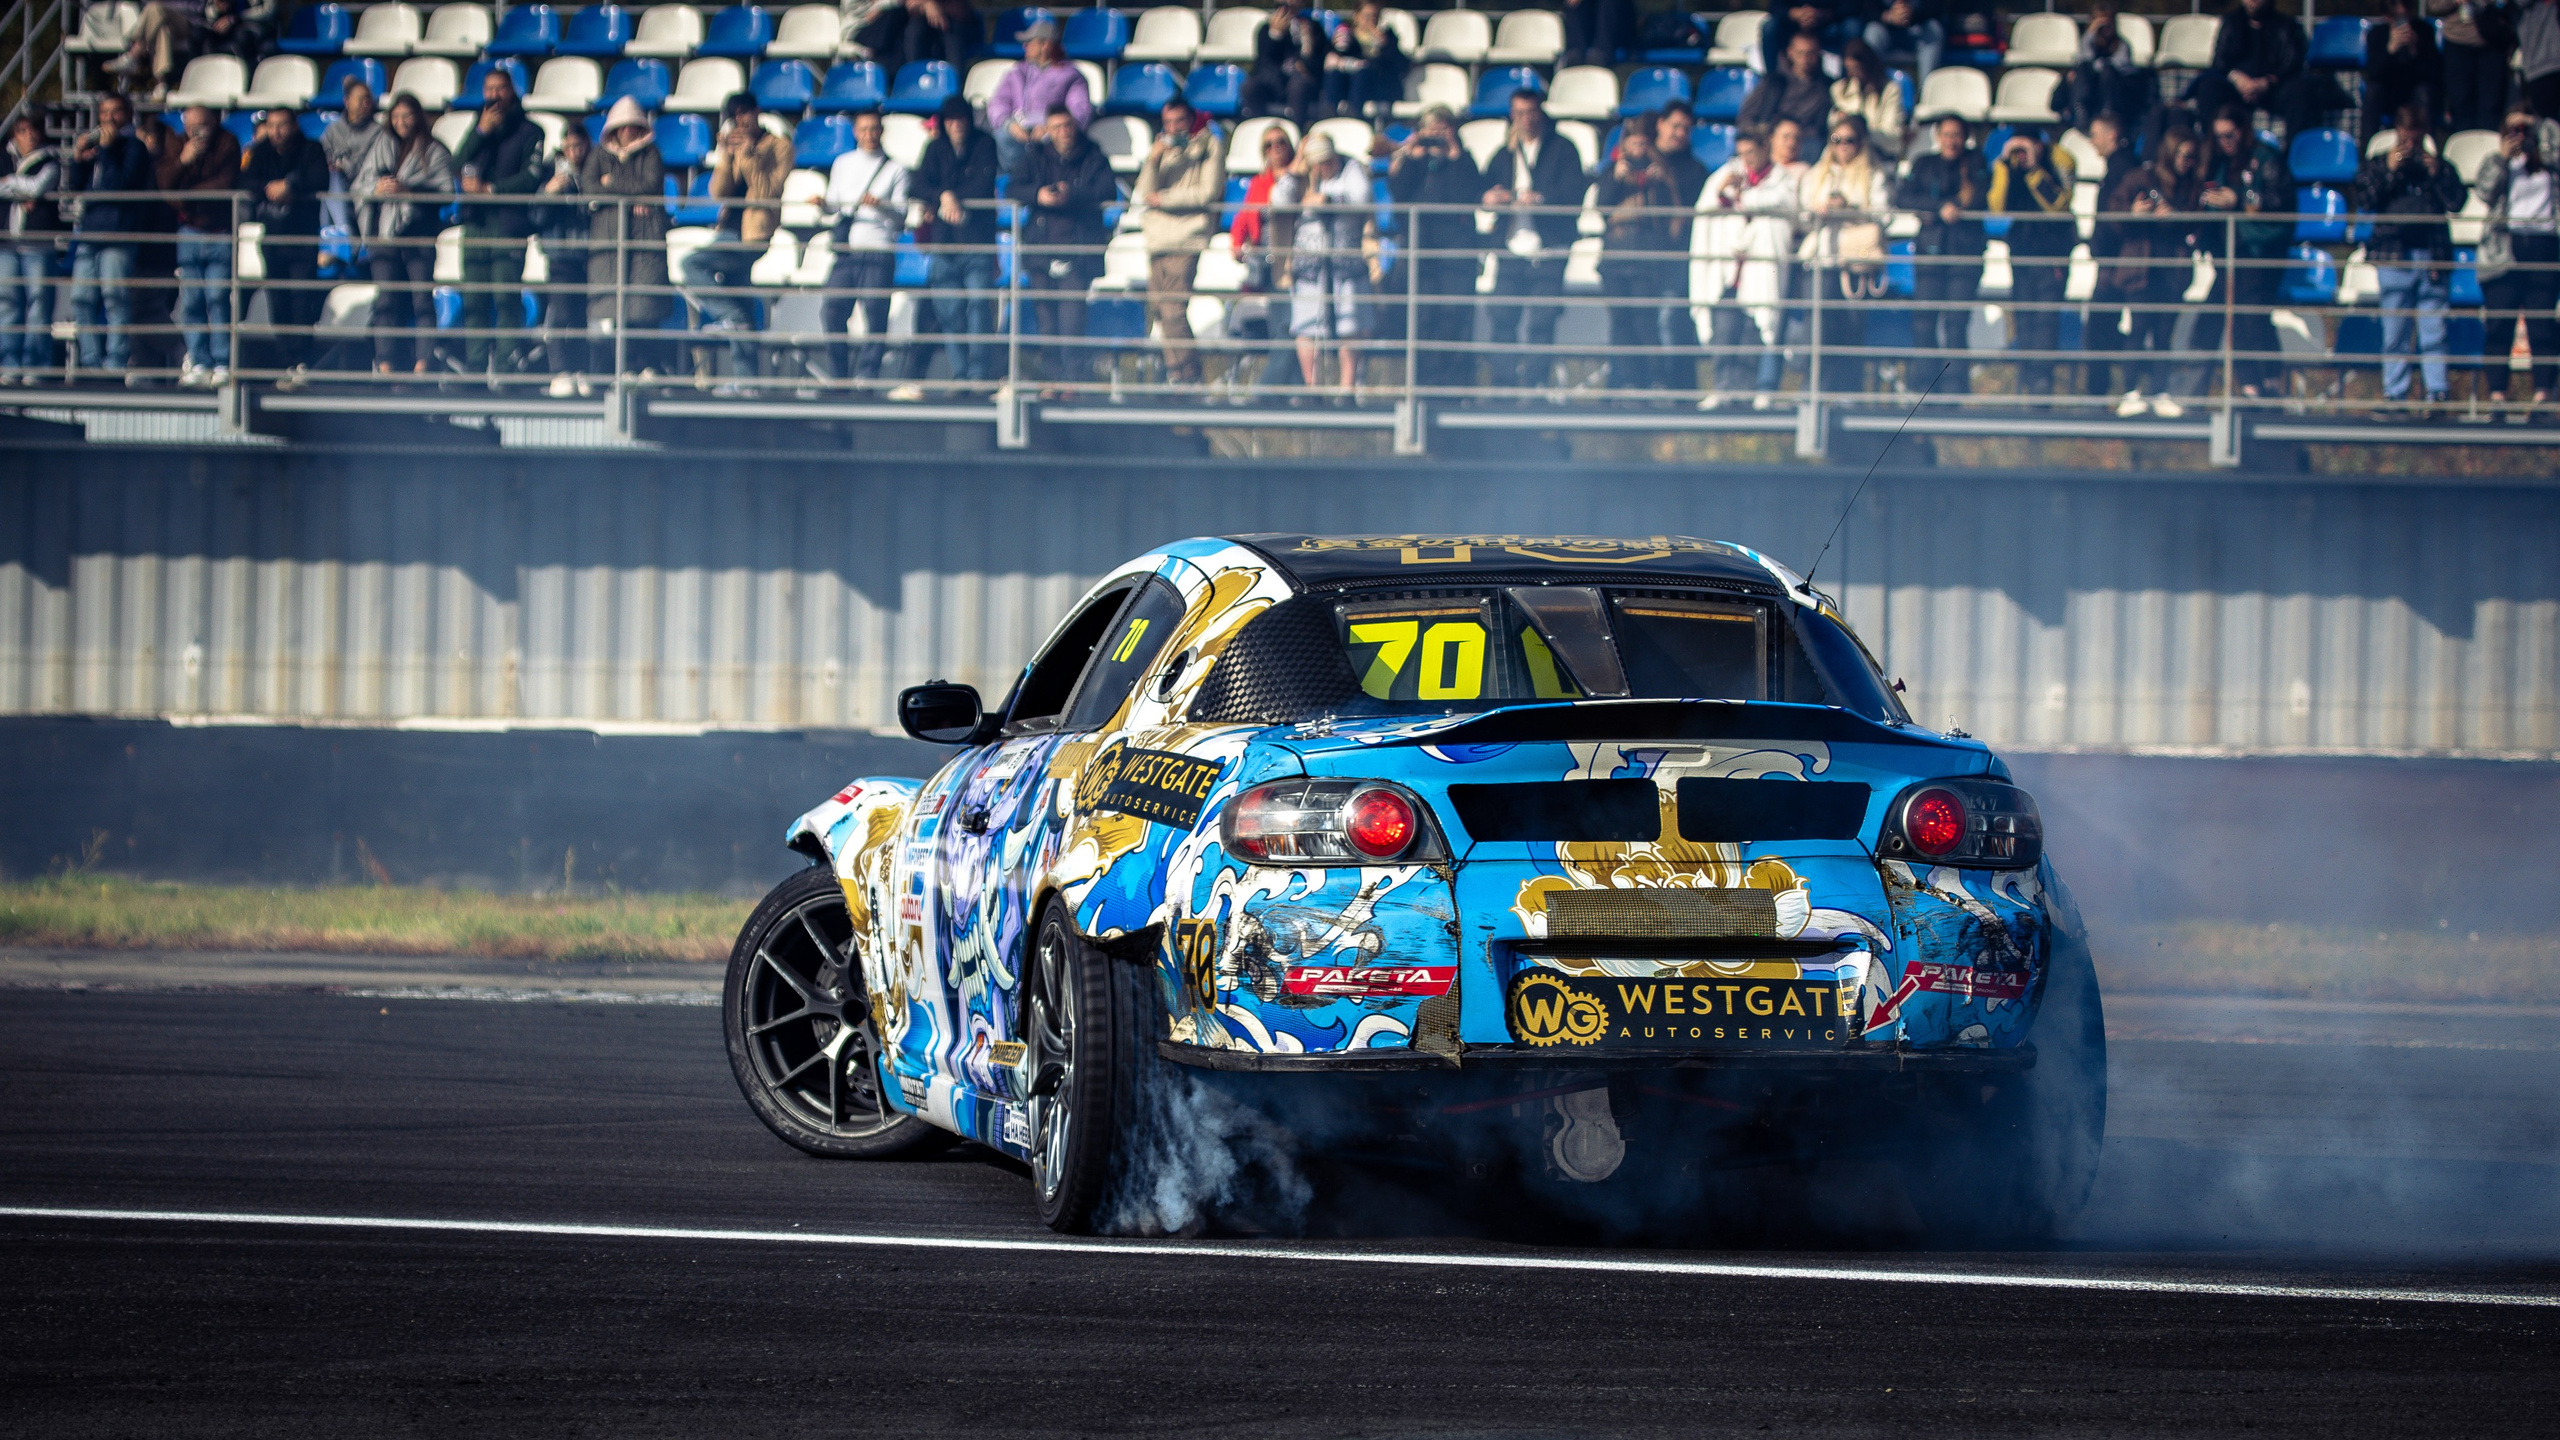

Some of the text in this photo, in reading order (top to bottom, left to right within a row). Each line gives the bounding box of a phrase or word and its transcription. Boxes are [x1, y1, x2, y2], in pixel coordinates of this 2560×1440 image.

[1111, 618, 1150, 662] 70
[1349, 620, 1486, 700] 70
[1118, 753, 1220, 799] WESTGATE
[1102, 794, 1198, 825] AUTOSERVICE
[1177, 918, 1218, 1014] 70
[1520, 993, 1599, 1035] WG
[1617, 984, 1857, 1017] WESTGATE
[1619, 1026, 1857, 1040] AUTOSERVICE
